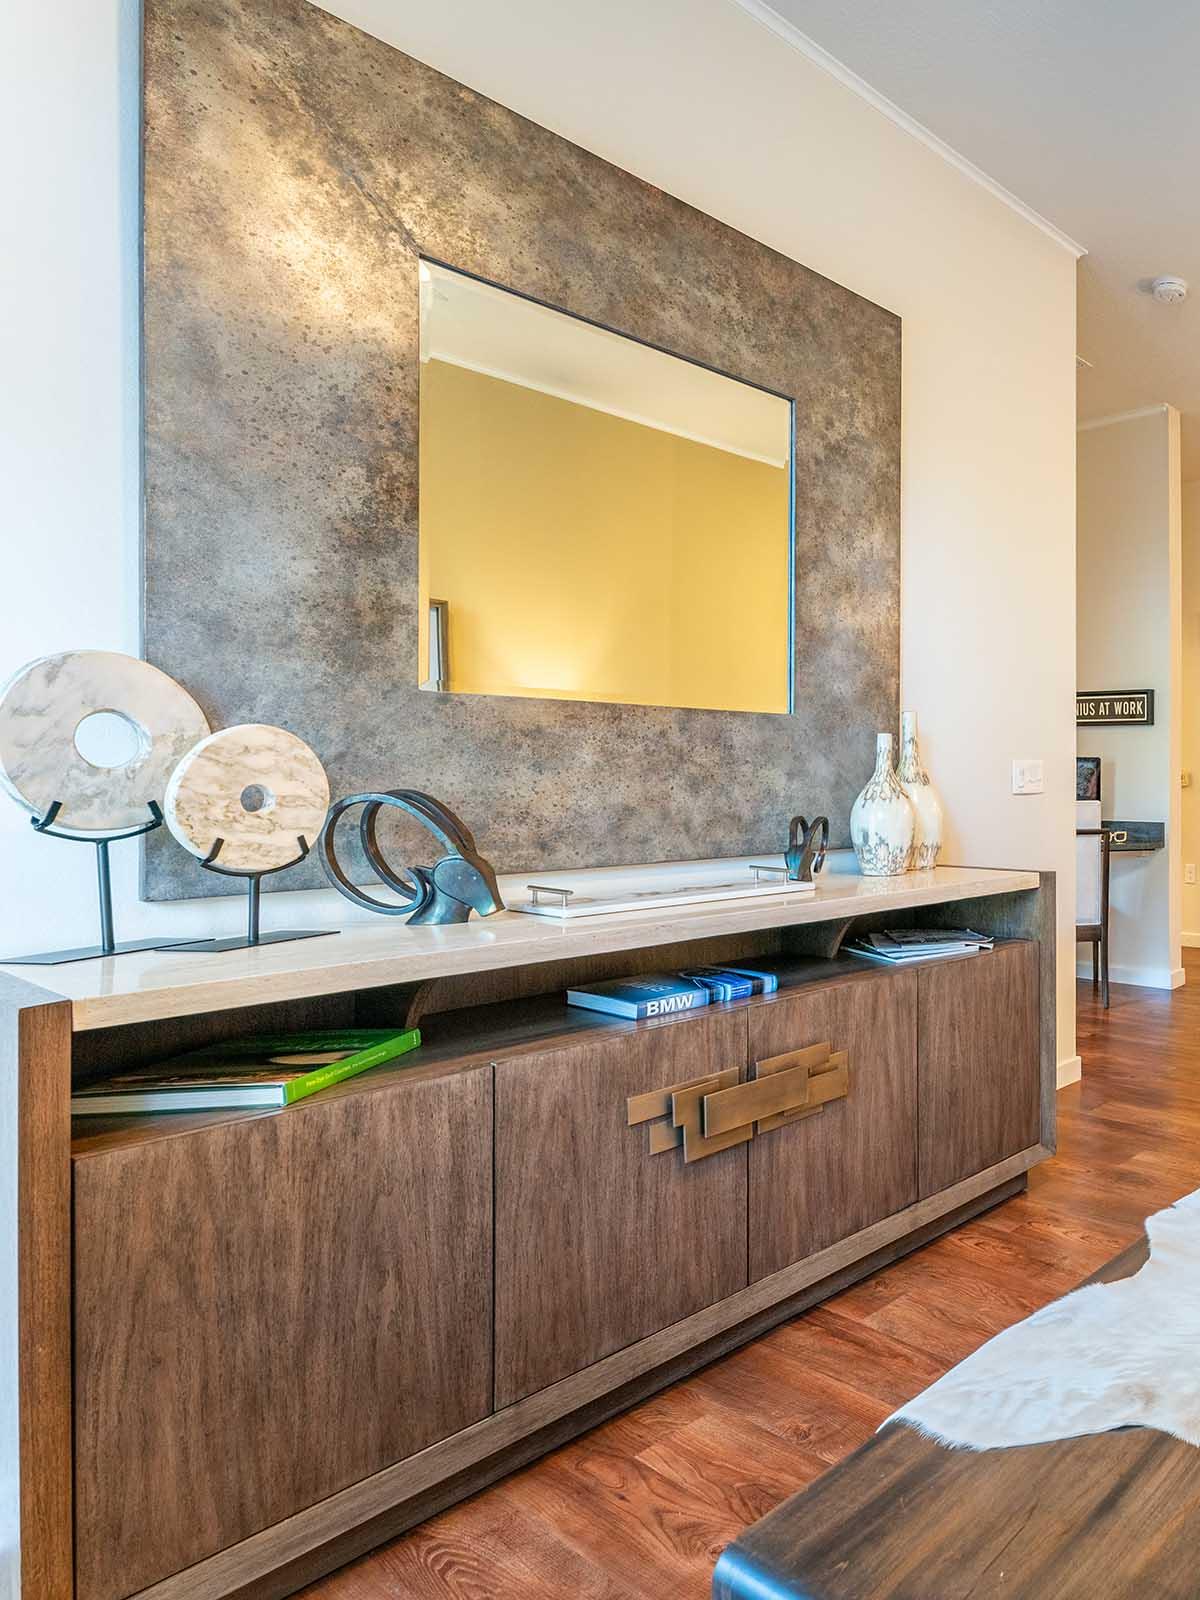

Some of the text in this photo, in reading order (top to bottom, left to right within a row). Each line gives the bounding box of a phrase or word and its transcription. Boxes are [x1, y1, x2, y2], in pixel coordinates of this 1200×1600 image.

[1099, 702, 1110, 715] AT
[1113, 701, 1143, 715] WORK
[646, 994, 693, 1016] BMW
